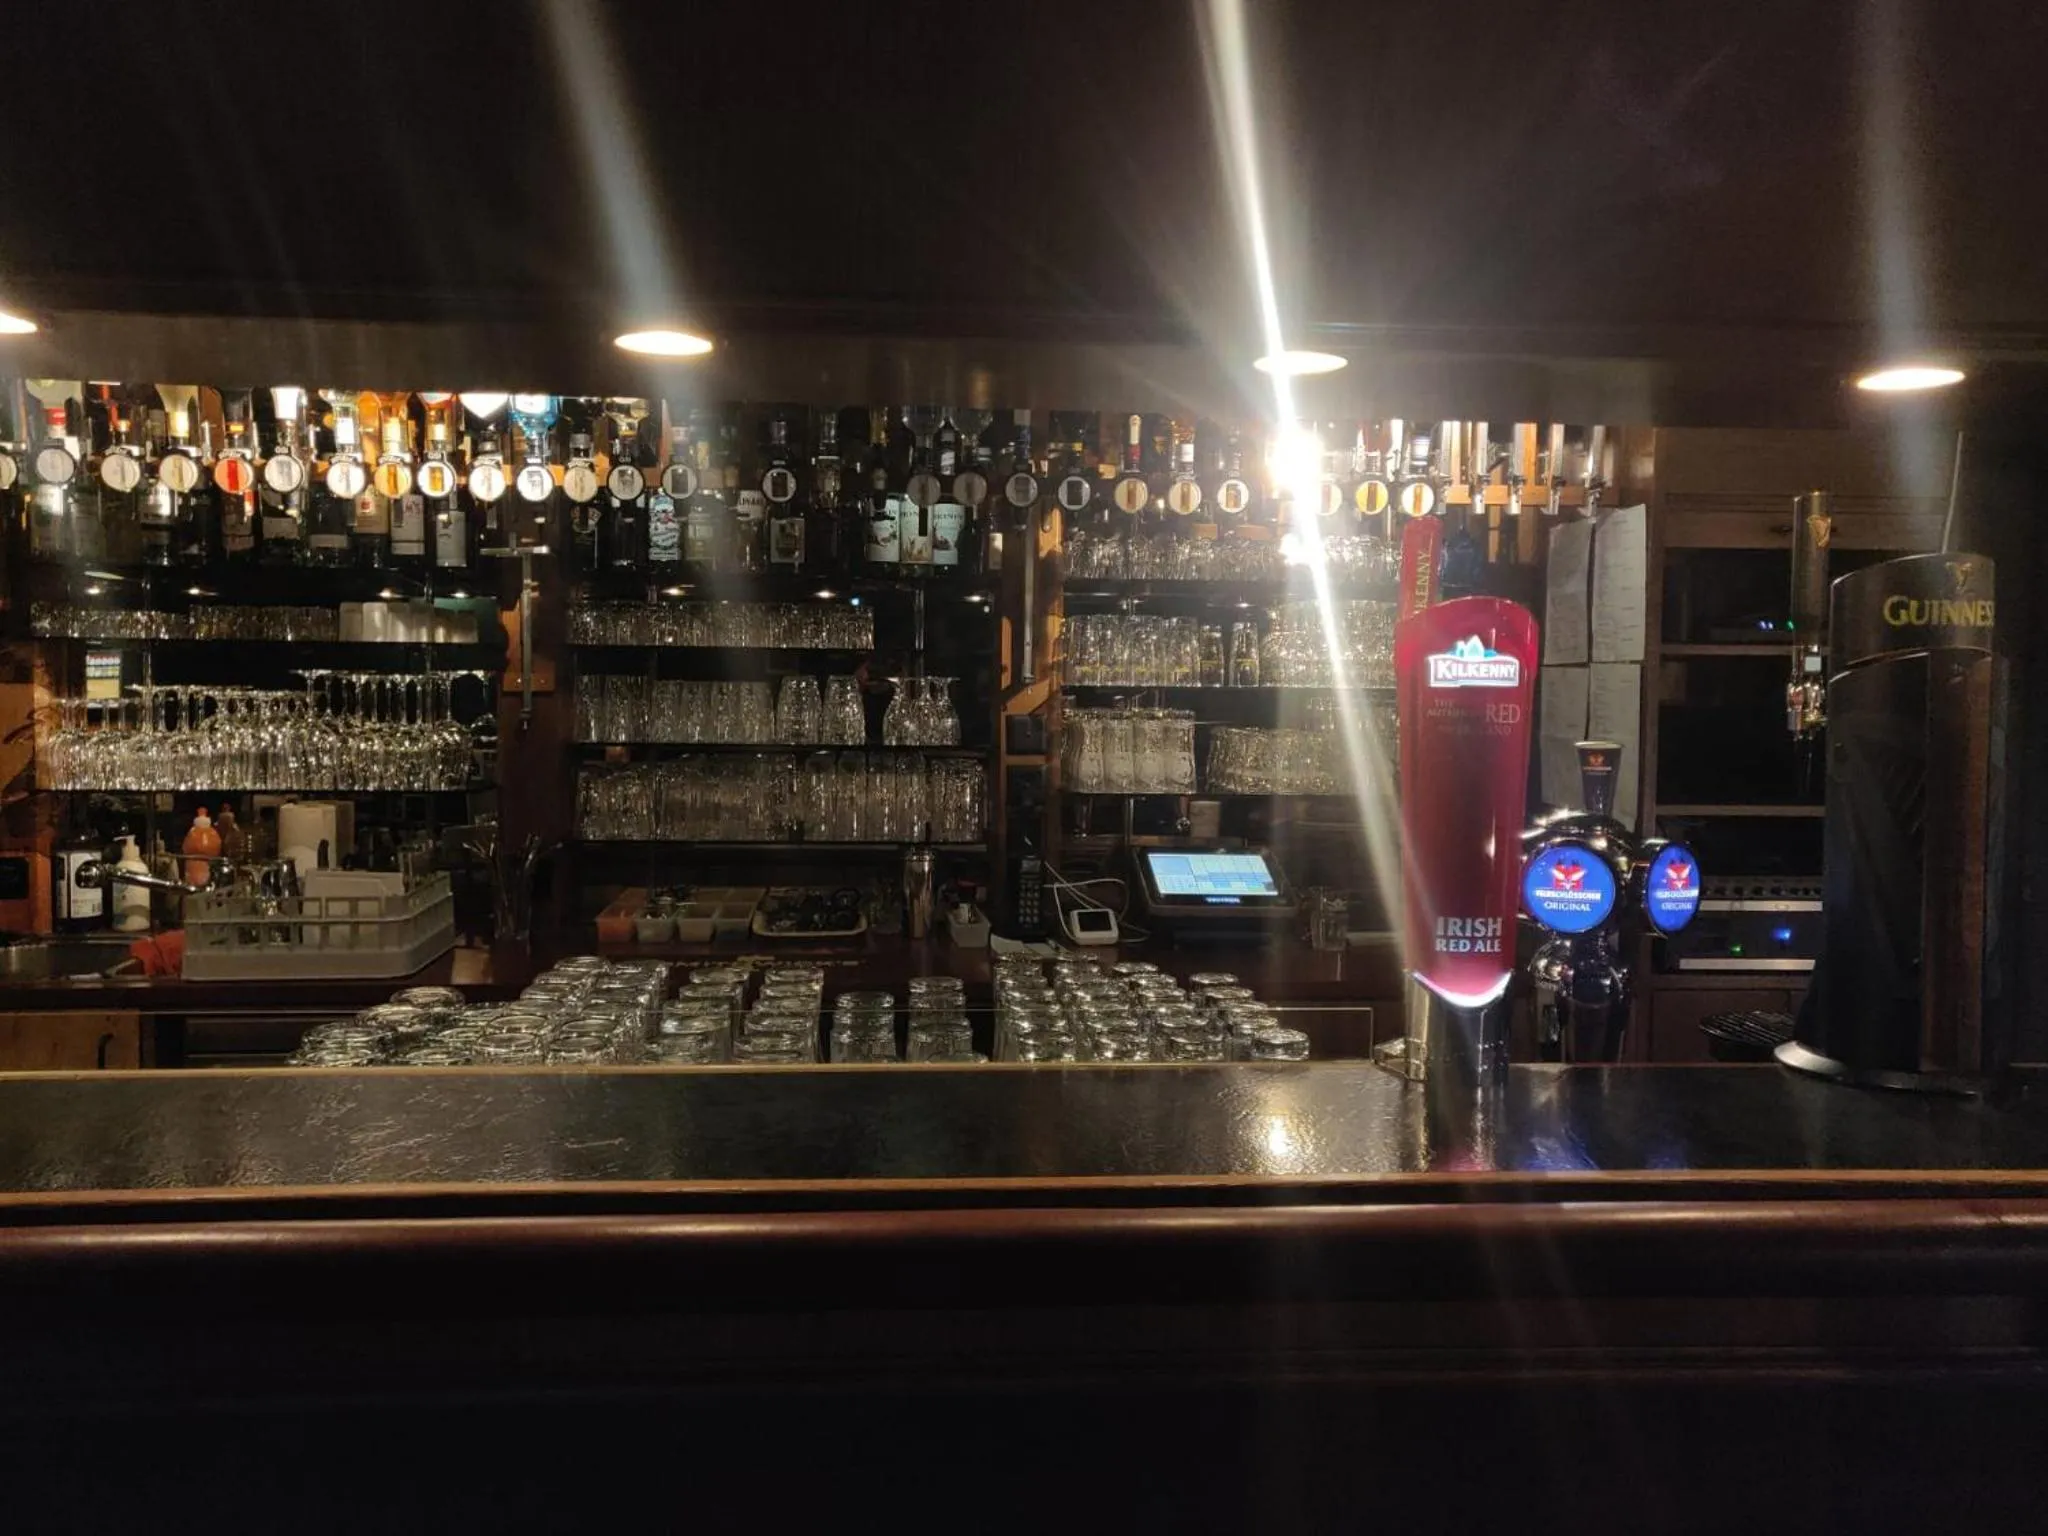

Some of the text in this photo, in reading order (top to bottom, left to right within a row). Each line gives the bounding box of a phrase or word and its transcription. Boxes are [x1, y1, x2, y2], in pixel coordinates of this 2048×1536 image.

[1414, 551, 1431, 611] KENNY
[1883, 595, 1994, 626] GUINNES
[1436, 660, 1516, 679] KILKENNY
[1486, 703, 1521, 724] RED
[1543, 900, 1593, 912] ORIGINAL
[1436, 916, 1503, 937] IRISH
[1435, 938, 1502, 953] RED ALE
